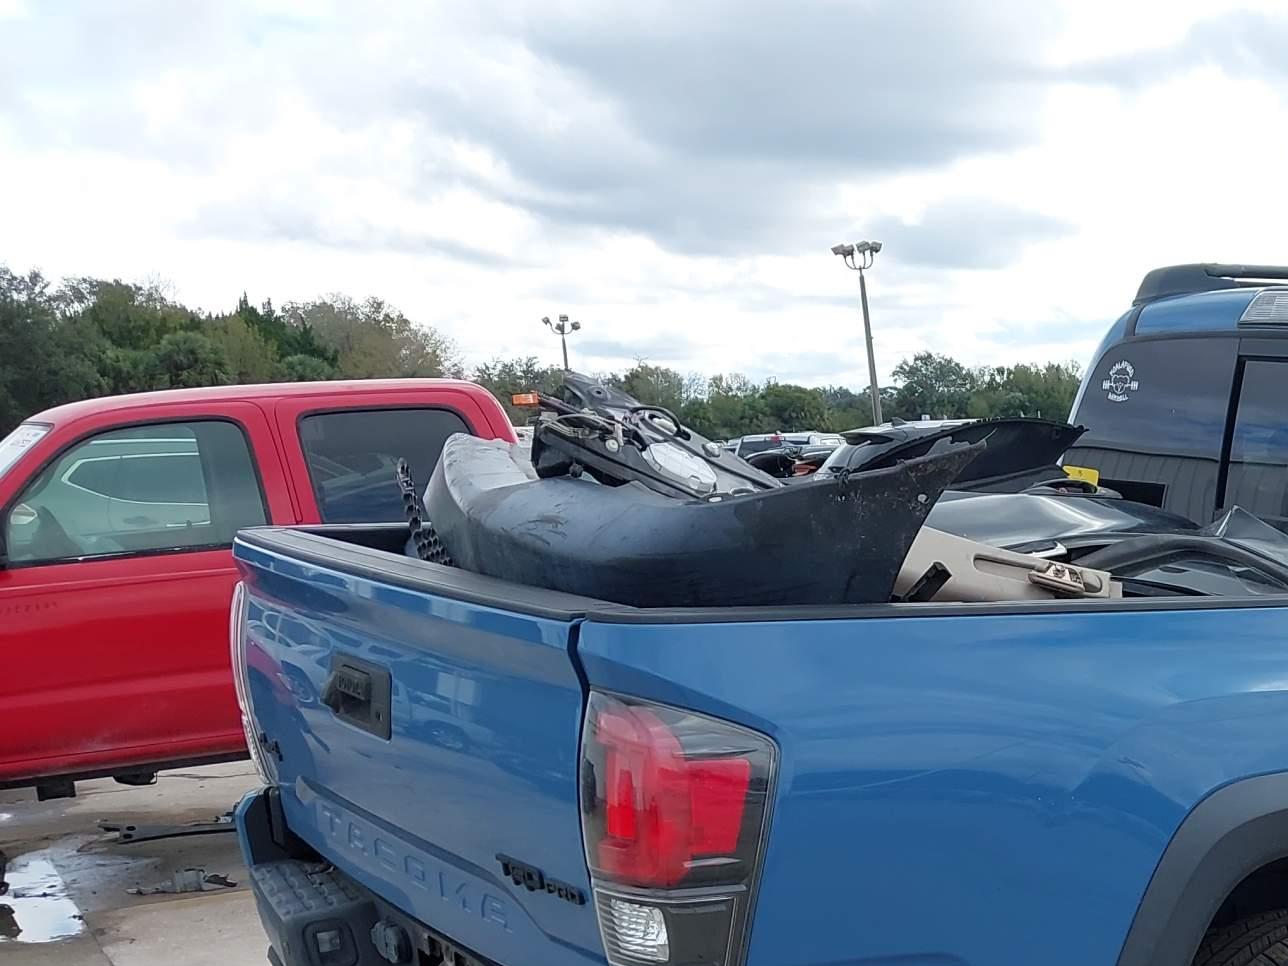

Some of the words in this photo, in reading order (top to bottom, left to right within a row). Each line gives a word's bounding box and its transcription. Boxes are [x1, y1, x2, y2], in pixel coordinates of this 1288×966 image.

[320, 801, 514, 934] TACOMA
[495, 853, 545, 892] TRD
[544, 879, 587, 905] PRO
